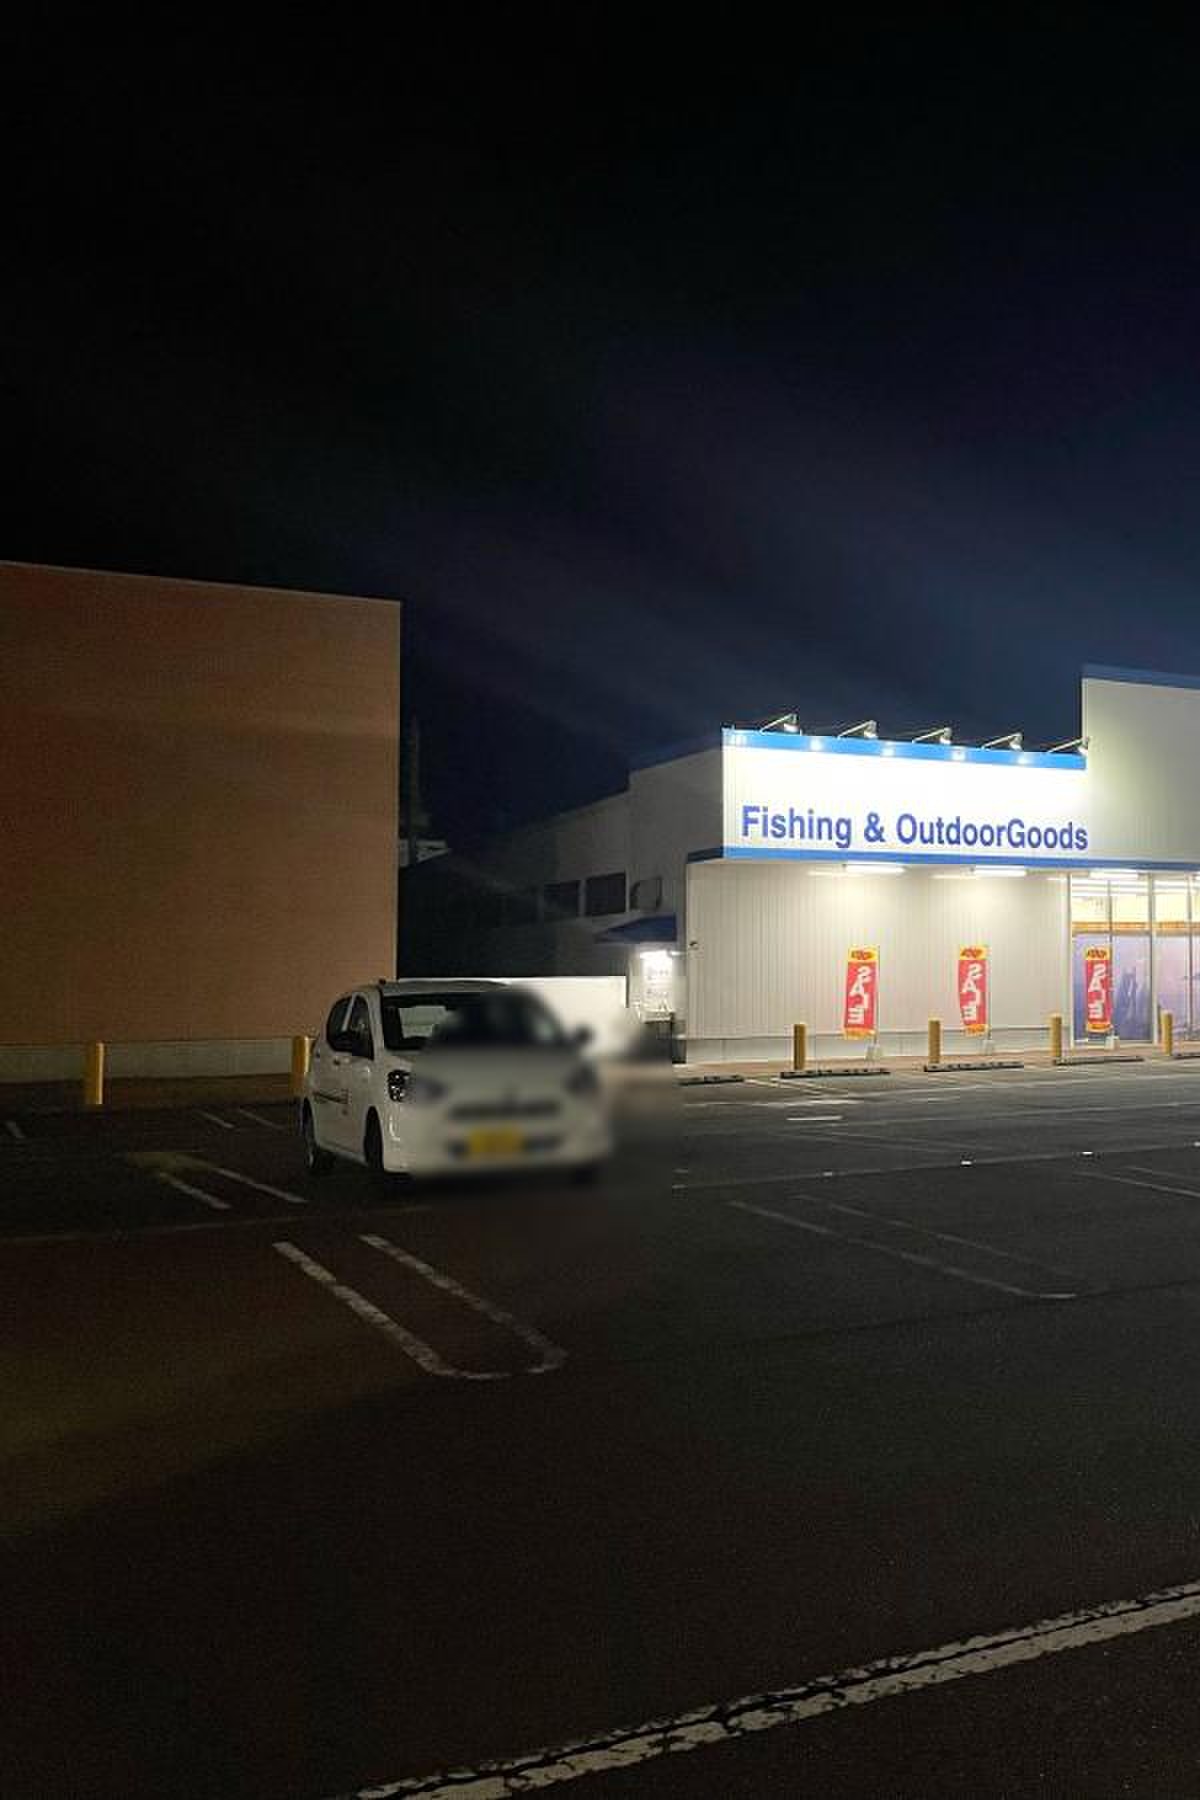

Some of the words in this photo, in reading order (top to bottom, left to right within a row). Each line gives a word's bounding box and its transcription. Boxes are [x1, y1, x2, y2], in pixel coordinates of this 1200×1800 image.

[742, 804, 851, 848] Fishing
[864, 812, 886, 843] &
[897, 813, 1089, 850] OutdoorGoods
